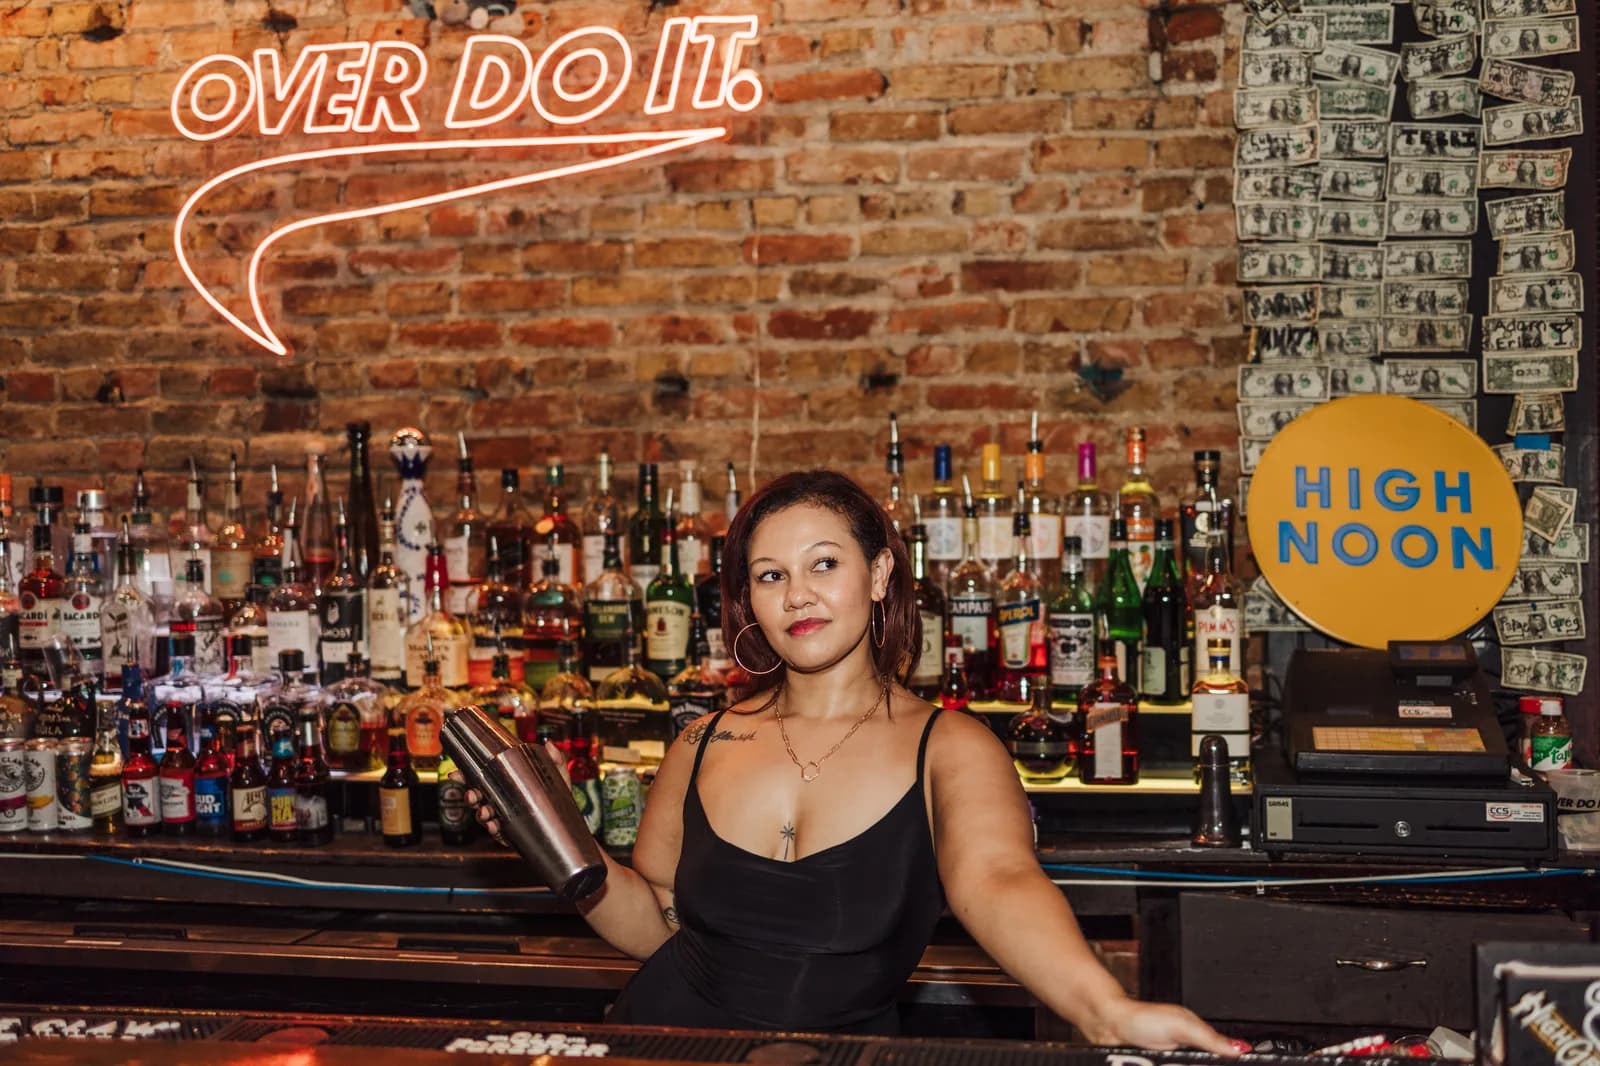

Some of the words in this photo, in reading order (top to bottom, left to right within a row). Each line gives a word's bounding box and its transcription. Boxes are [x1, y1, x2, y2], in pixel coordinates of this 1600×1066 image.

[171, 41, 427, 141] OVER
[444, 26, 632, 128] DO
[644, 15, 763, 114] IT.
[1294, 465, 1473, 514] HIGH
[1277, 520, 1494, 571] NOON
